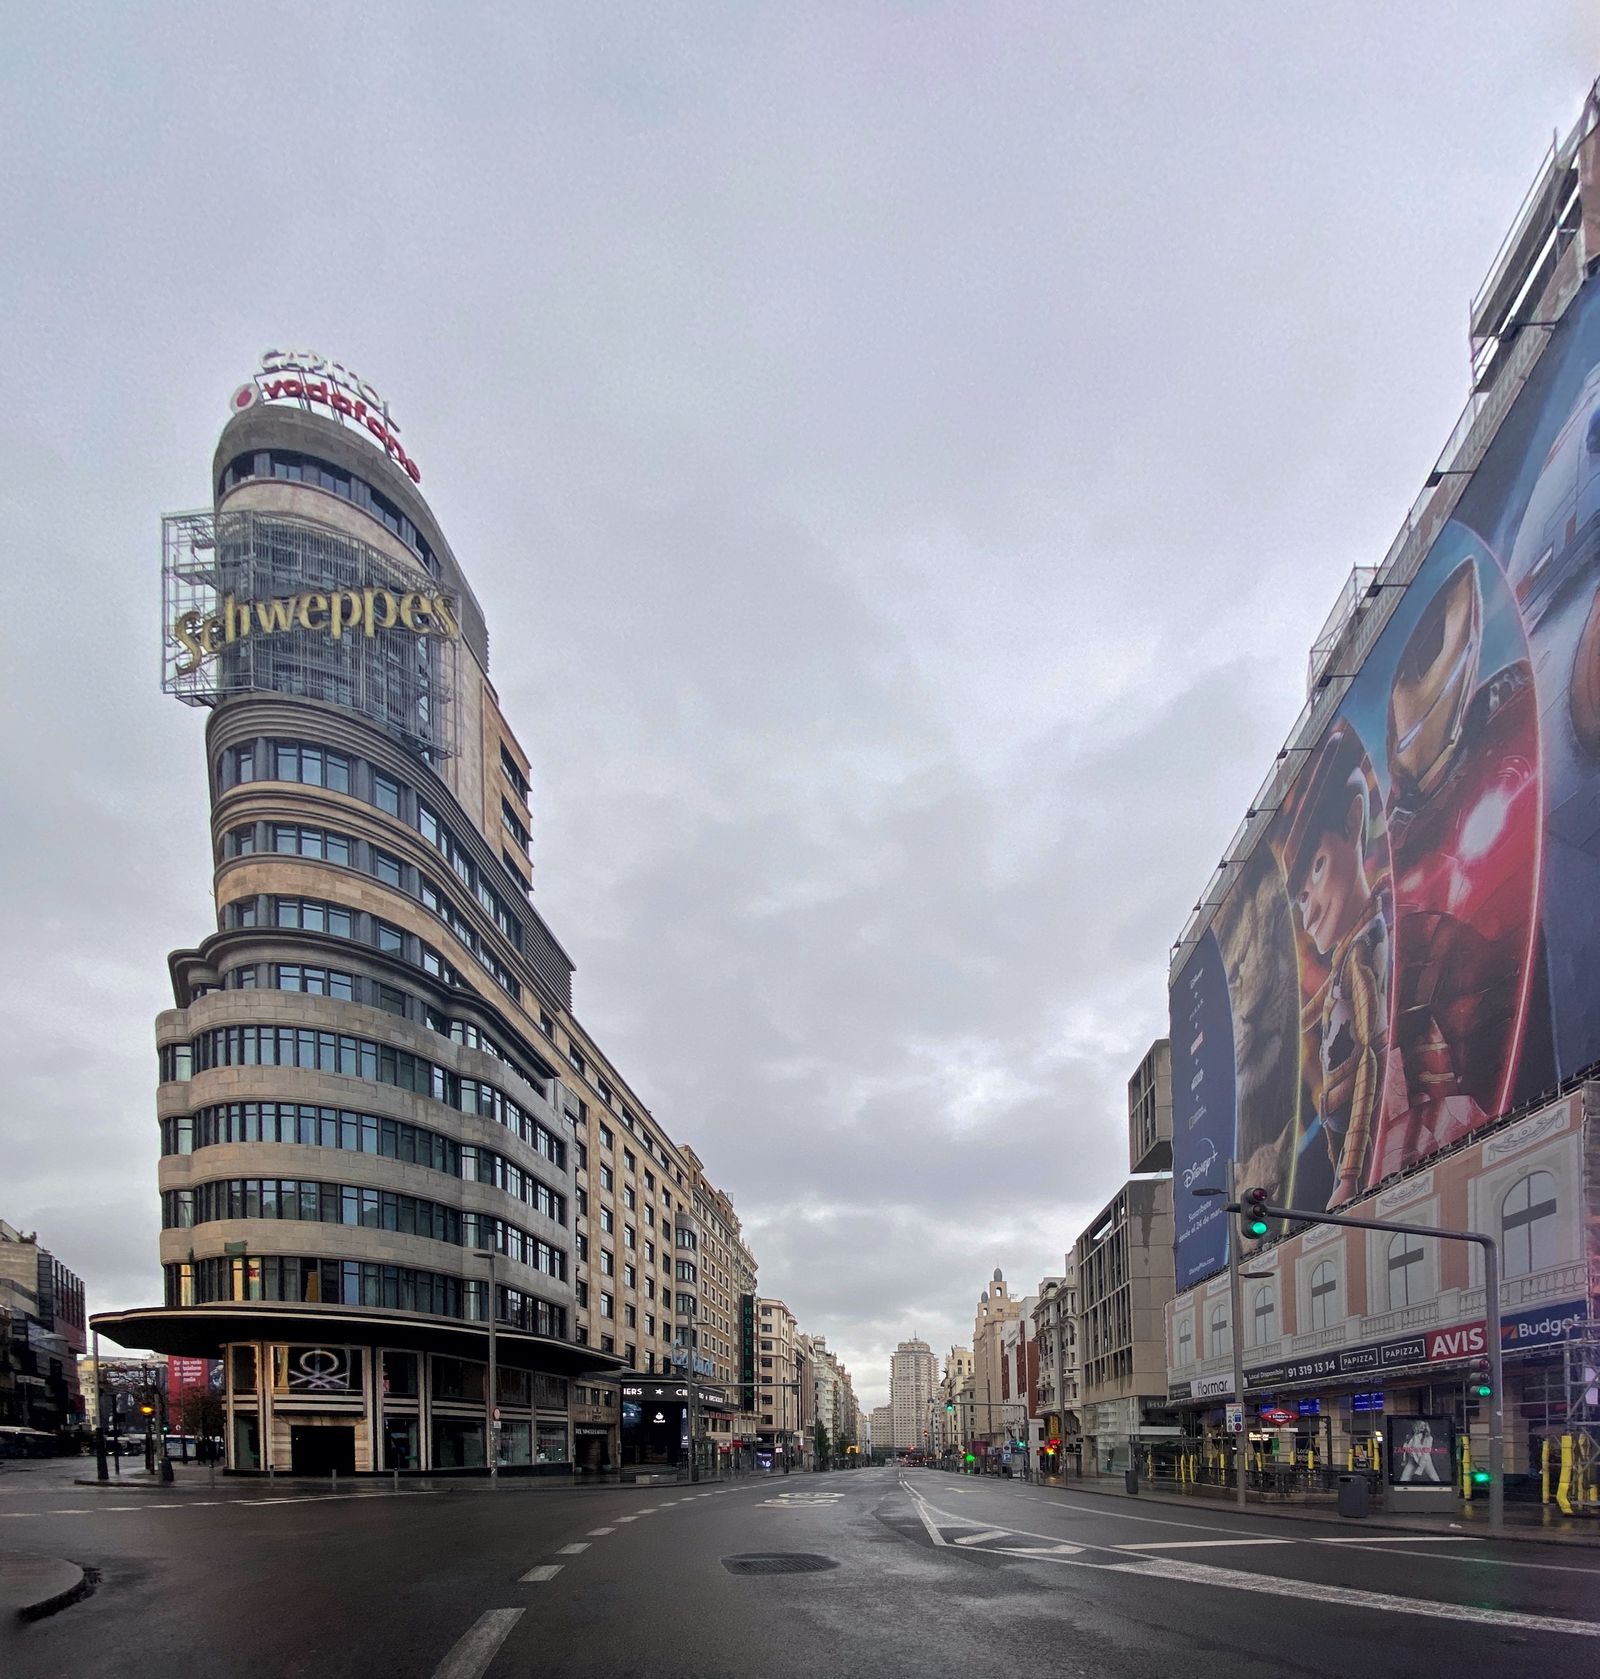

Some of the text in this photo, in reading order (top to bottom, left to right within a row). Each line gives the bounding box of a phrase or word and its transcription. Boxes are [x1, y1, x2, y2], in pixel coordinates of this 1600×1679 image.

[175, 586, 461, 675] Schweppes
[744, 1307, 753, 1356] HOTEL
[1518, 1313, 1581, 1337] Budget
[1385, 1346, 1420, 1359] PAPIZZA
[1431, 1327, 1484, 1358] AVIS
[1287, 1360, 1336, 1378] 91 319 13 14
[1343, 1354, 1374, 1366] PAPIZZA
[1197, 1380, 1228, 1395] flormar
